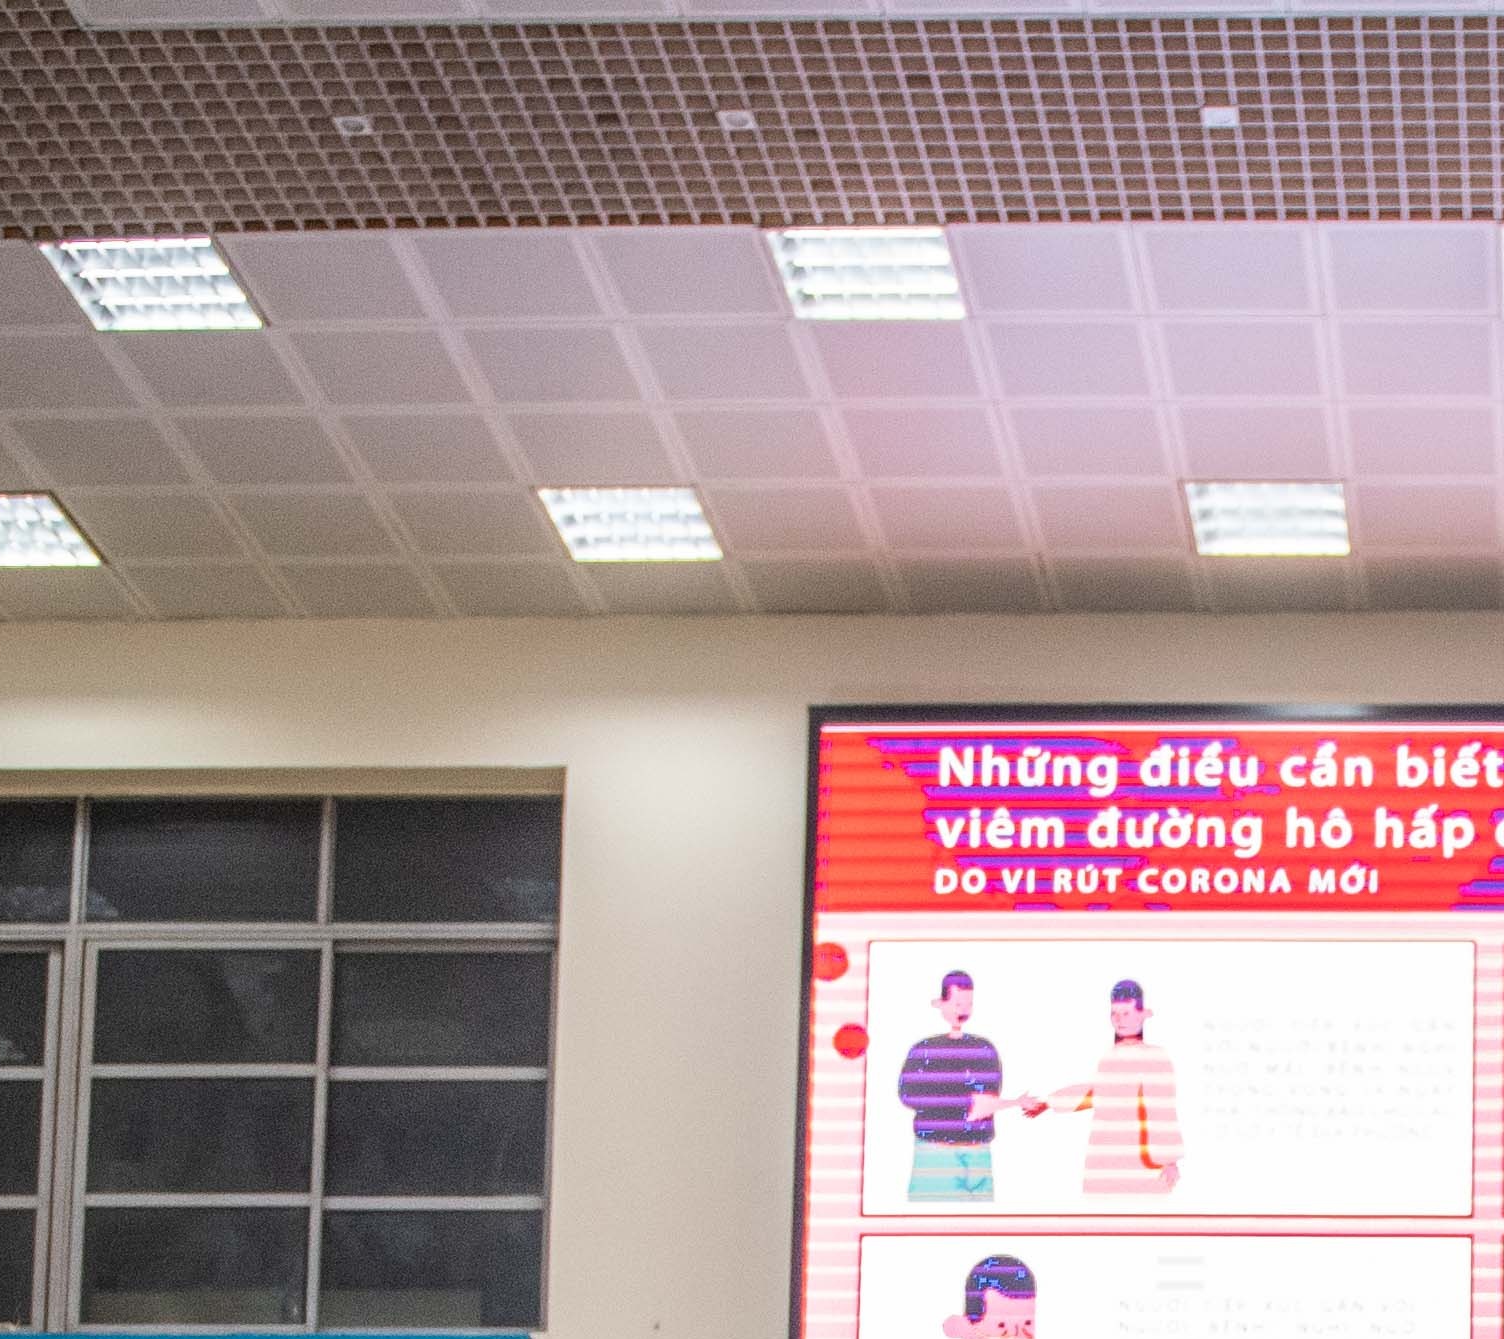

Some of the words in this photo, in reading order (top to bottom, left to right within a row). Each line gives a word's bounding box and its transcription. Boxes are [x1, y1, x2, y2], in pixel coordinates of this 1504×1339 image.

[938, 746, 1117, 797] Những
[1398, 742, 1504, 788] biết
[936, 808, 1065, 848] viêm
[1087, 807, 1263, 858] đường
[1286, 807, 1353, 848] hô
[1374, 804, 1475, 857] hấp
[934, 868, 987, 895] DO
[1003, 869, 1036, 894] VI
[1054, 864, 1123, 895] RÚT
[1137, 868, 1292, 895] CORONA
[1308, 863, 1379, 895] MỚI
